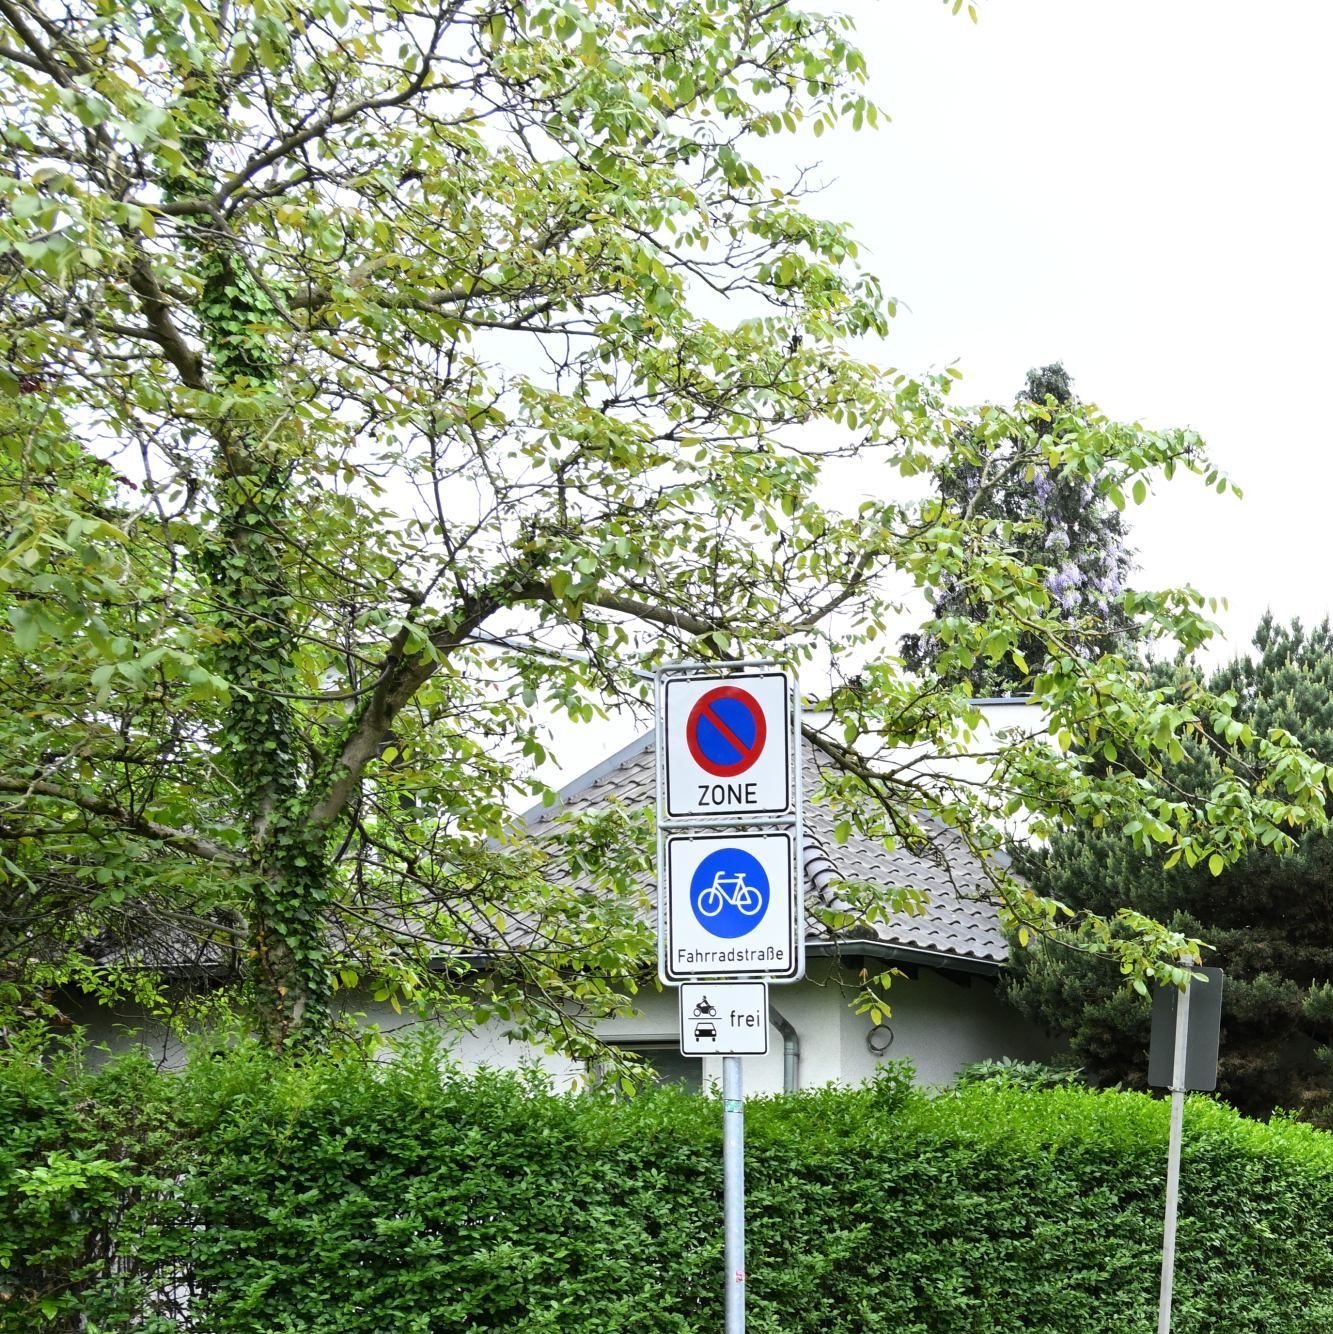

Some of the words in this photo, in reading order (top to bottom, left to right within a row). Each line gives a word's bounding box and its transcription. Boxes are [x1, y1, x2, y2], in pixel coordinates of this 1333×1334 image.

[697, 783, 758, 806] ZONE
[677, 946, 784, 964] Fahrradstraße
[729, 1009, 761, 1028] frei
